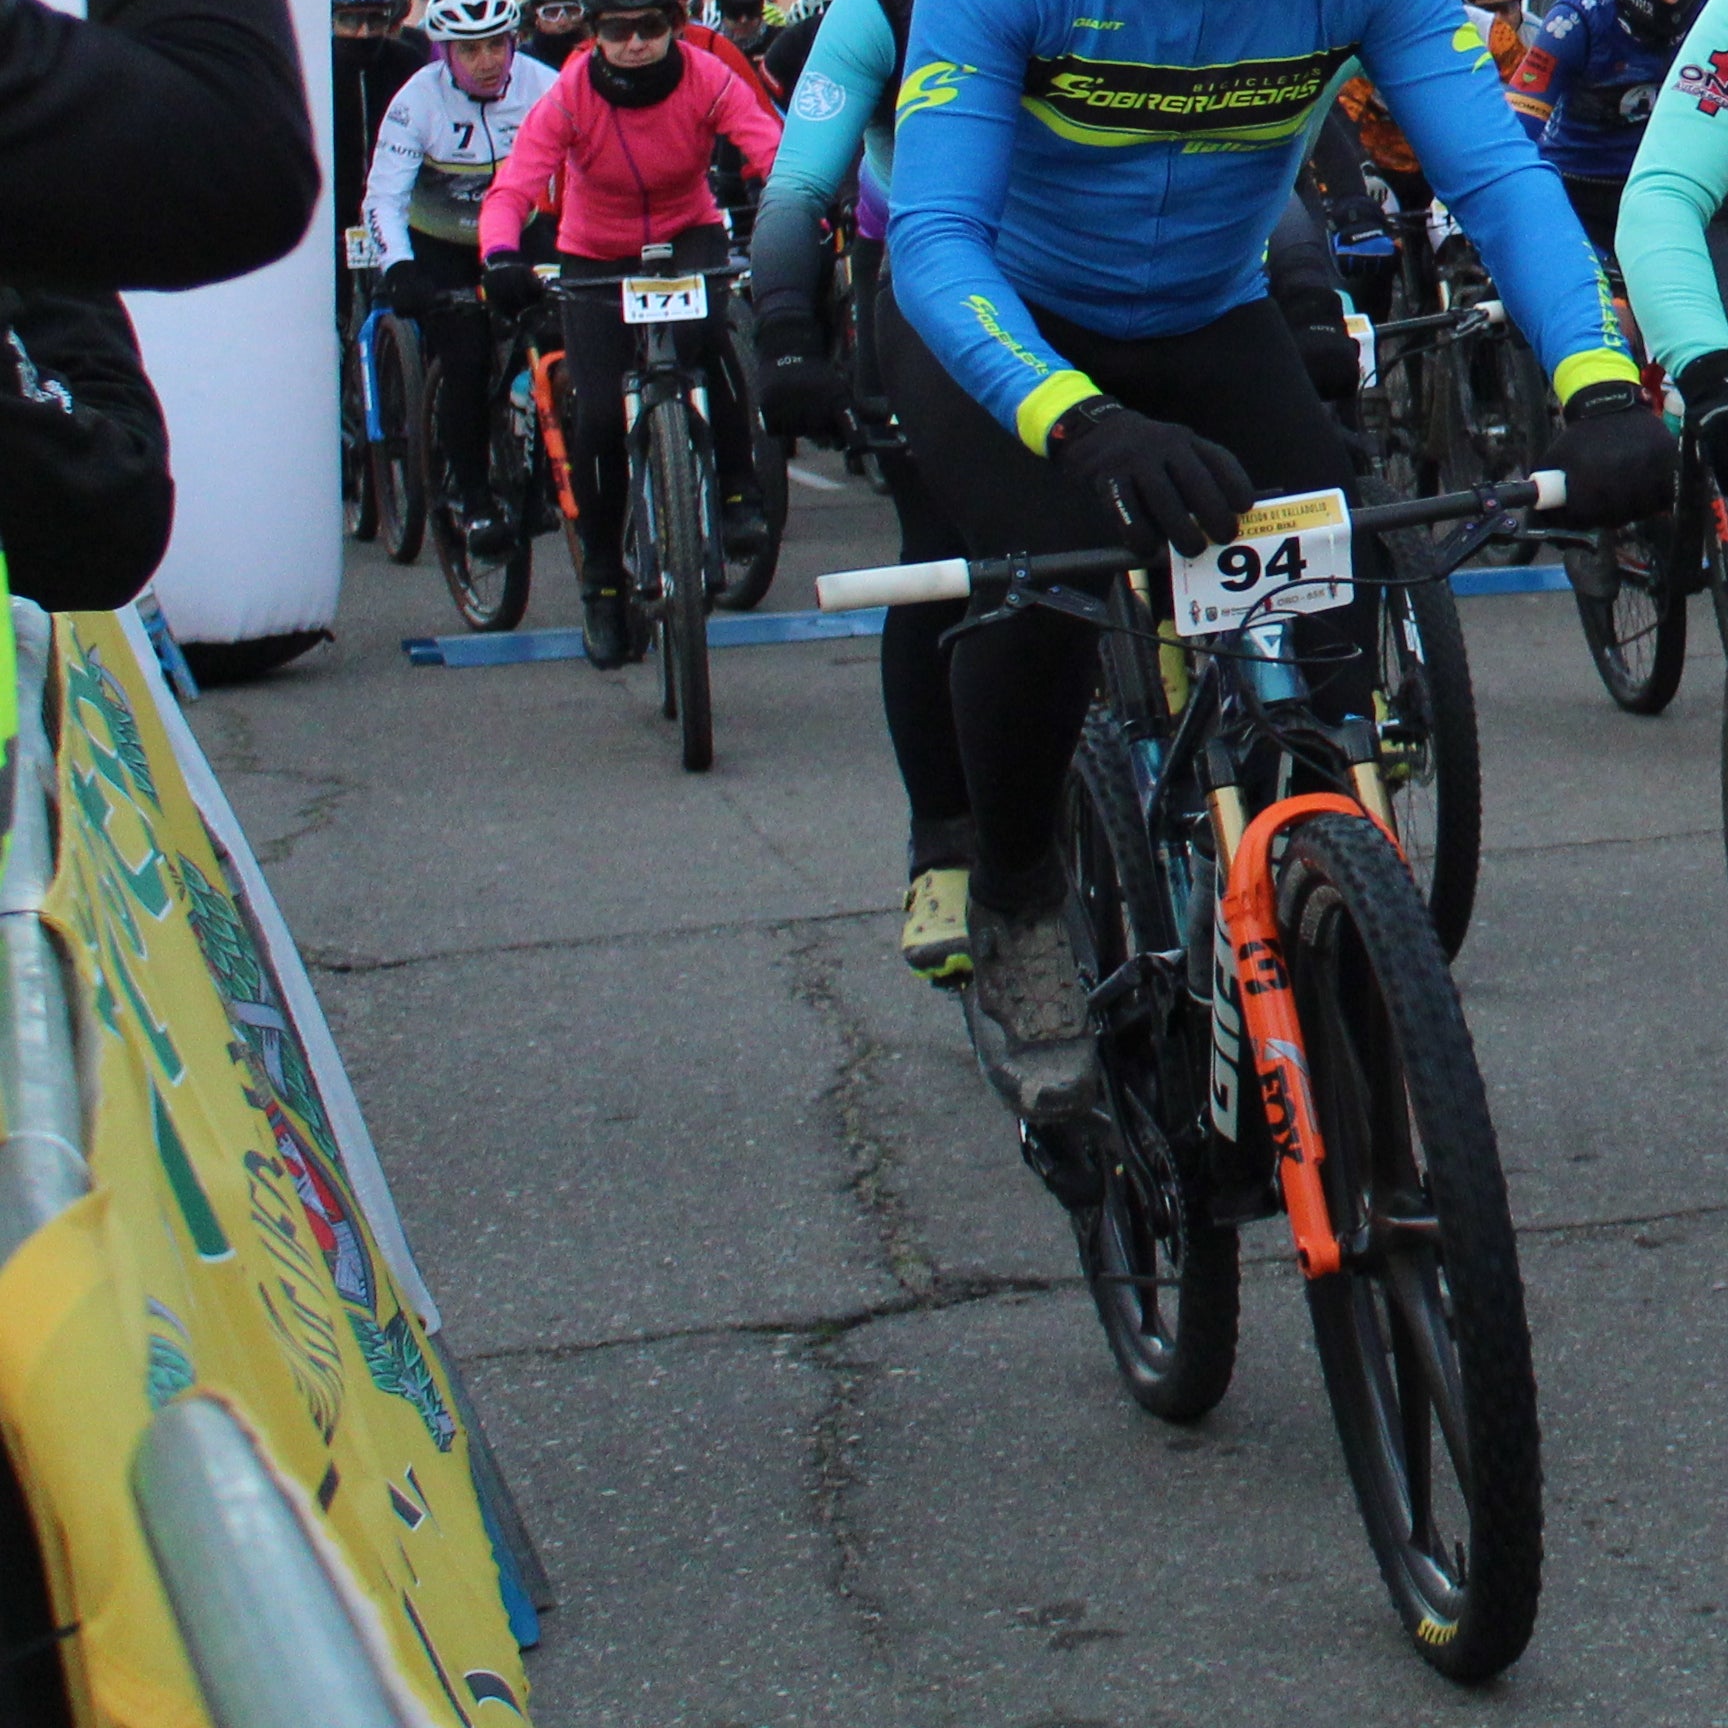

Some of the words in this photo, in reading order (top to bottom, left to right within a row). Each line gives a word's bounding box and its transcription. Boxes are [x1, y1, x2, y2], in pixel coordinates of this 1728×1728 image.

[1073, 18, 1124, 31] GIANT
[1046, 72, 1321, 114] SOBRERUEDAS
[636, 292, 691, 309] 171
[1216, 535, 1308, 593] 94
[1257, 1066, 1304, 1165] FOX
